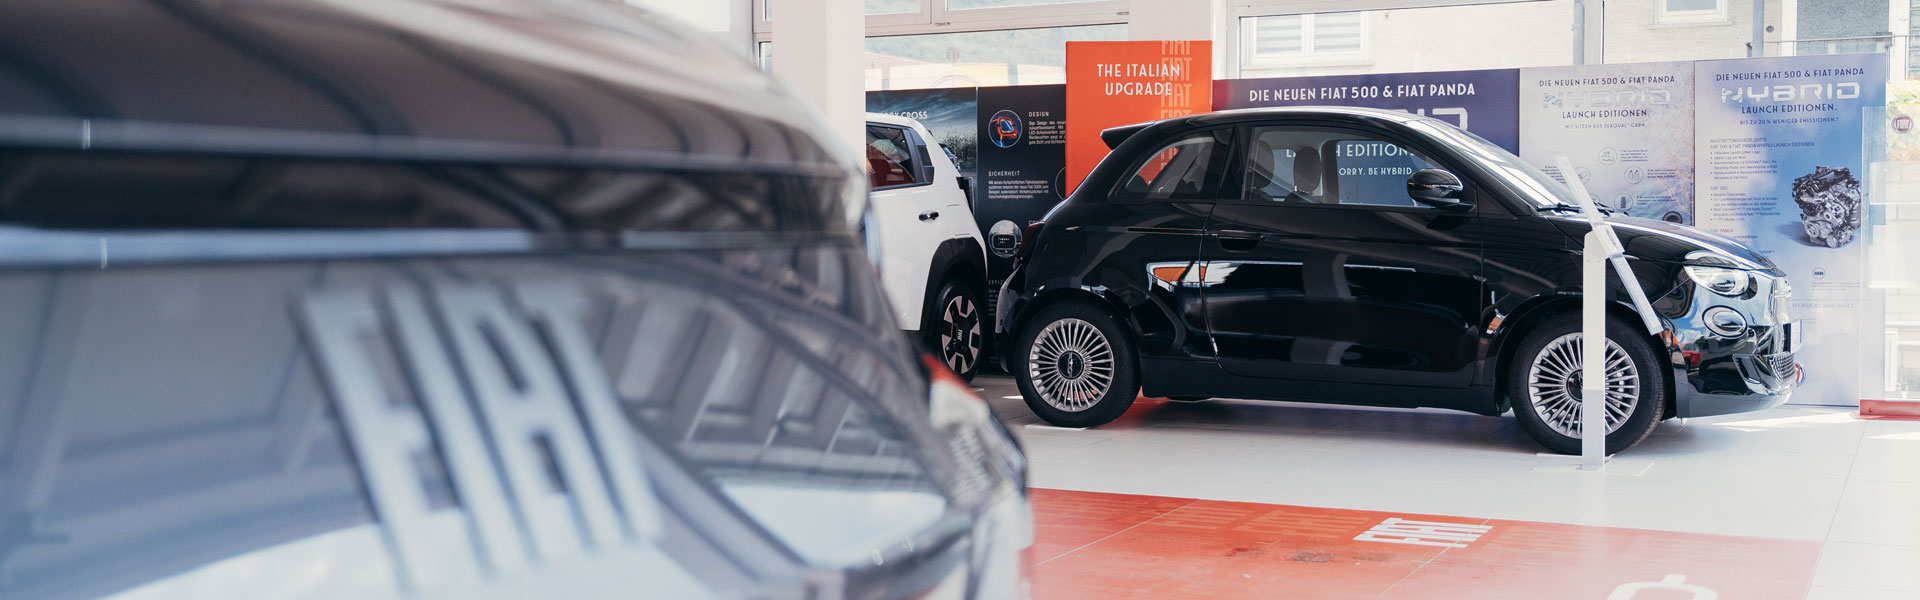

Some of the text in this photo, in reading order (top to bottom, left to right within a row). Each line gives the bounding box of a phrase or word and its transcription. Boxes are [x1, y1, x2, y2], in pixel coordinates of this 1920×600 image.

[1096, 63, 1180, 77] THE ITALIAN
[1161, 57, 1193, 81] FIAT
[1716, 73, 1730, 81] DIE
[1732, 72, 1761, 80] NEUEN
[1763, 71, 1782, 79] FIAT
[1784, 70, 1801, 78] 500
[1813, 69, 1832, 77] FIAT
[1834, 67, 1865, 76] PANDA
[1538, 79, 1552, 87] DIE
[1582, 78, 1599, 86] FIAT
[1601, 77, 1618, 85] 500
[1620, 76, 1626, 85] &
[1628, 76, 1646, 84] FIAT
[1648, 75, 1676, 83] PANDA
[1105, 82, 1173, 96] UPGRADE
[1249, 82, 1476, 102] DIE NEUEN FIAT 500 & FIAT PANDA
[1721, 82, 1861, 104] HYBRID
[1562, 109, 1651, 119] LAUNCH EDITIONEN.
[1741, 103, 1838, 114] LAUNCH EDITIONEN.
[1339, 166, 1413, 176] ORRY. BE HYBRID
[303, 280, 664, 592] FIAT
[1353, 517, 1494, 548] FIAT
